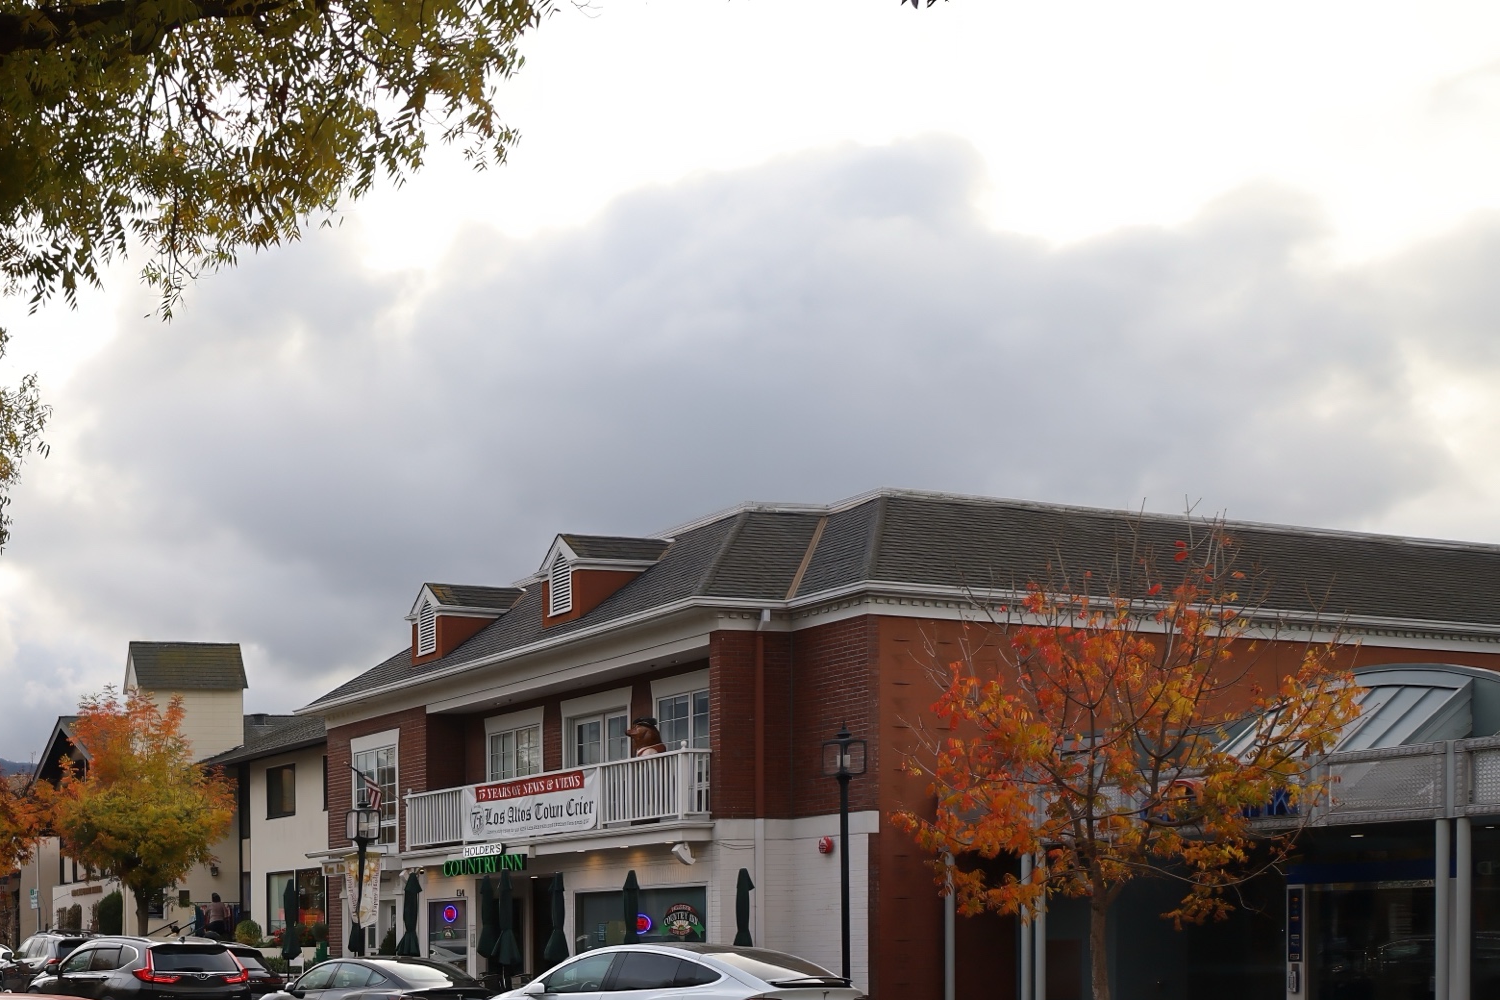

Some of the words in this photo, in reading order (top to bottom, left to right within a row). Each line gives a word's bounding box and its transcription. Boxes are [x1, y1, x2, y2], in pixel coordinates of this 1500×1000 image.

[487, 787, 512, 799] YEARS
[512, 786, 521, 796] OF
[523, 781, 545, 795] NEWS
[547, 779, 554, 790] &
[555, 775, 581, 789] VIEWS
[485, 808, 506, 826] Los
[507, 806, 532, 823] Altos
[534, 802, 563, 821] Town
[566, 796, 594, 817] Crier
[464, 844, 501, 857] HOLDER'S
[443, 856, 498, 877] COUNTRY
[500, 854, 523, 871] INN
